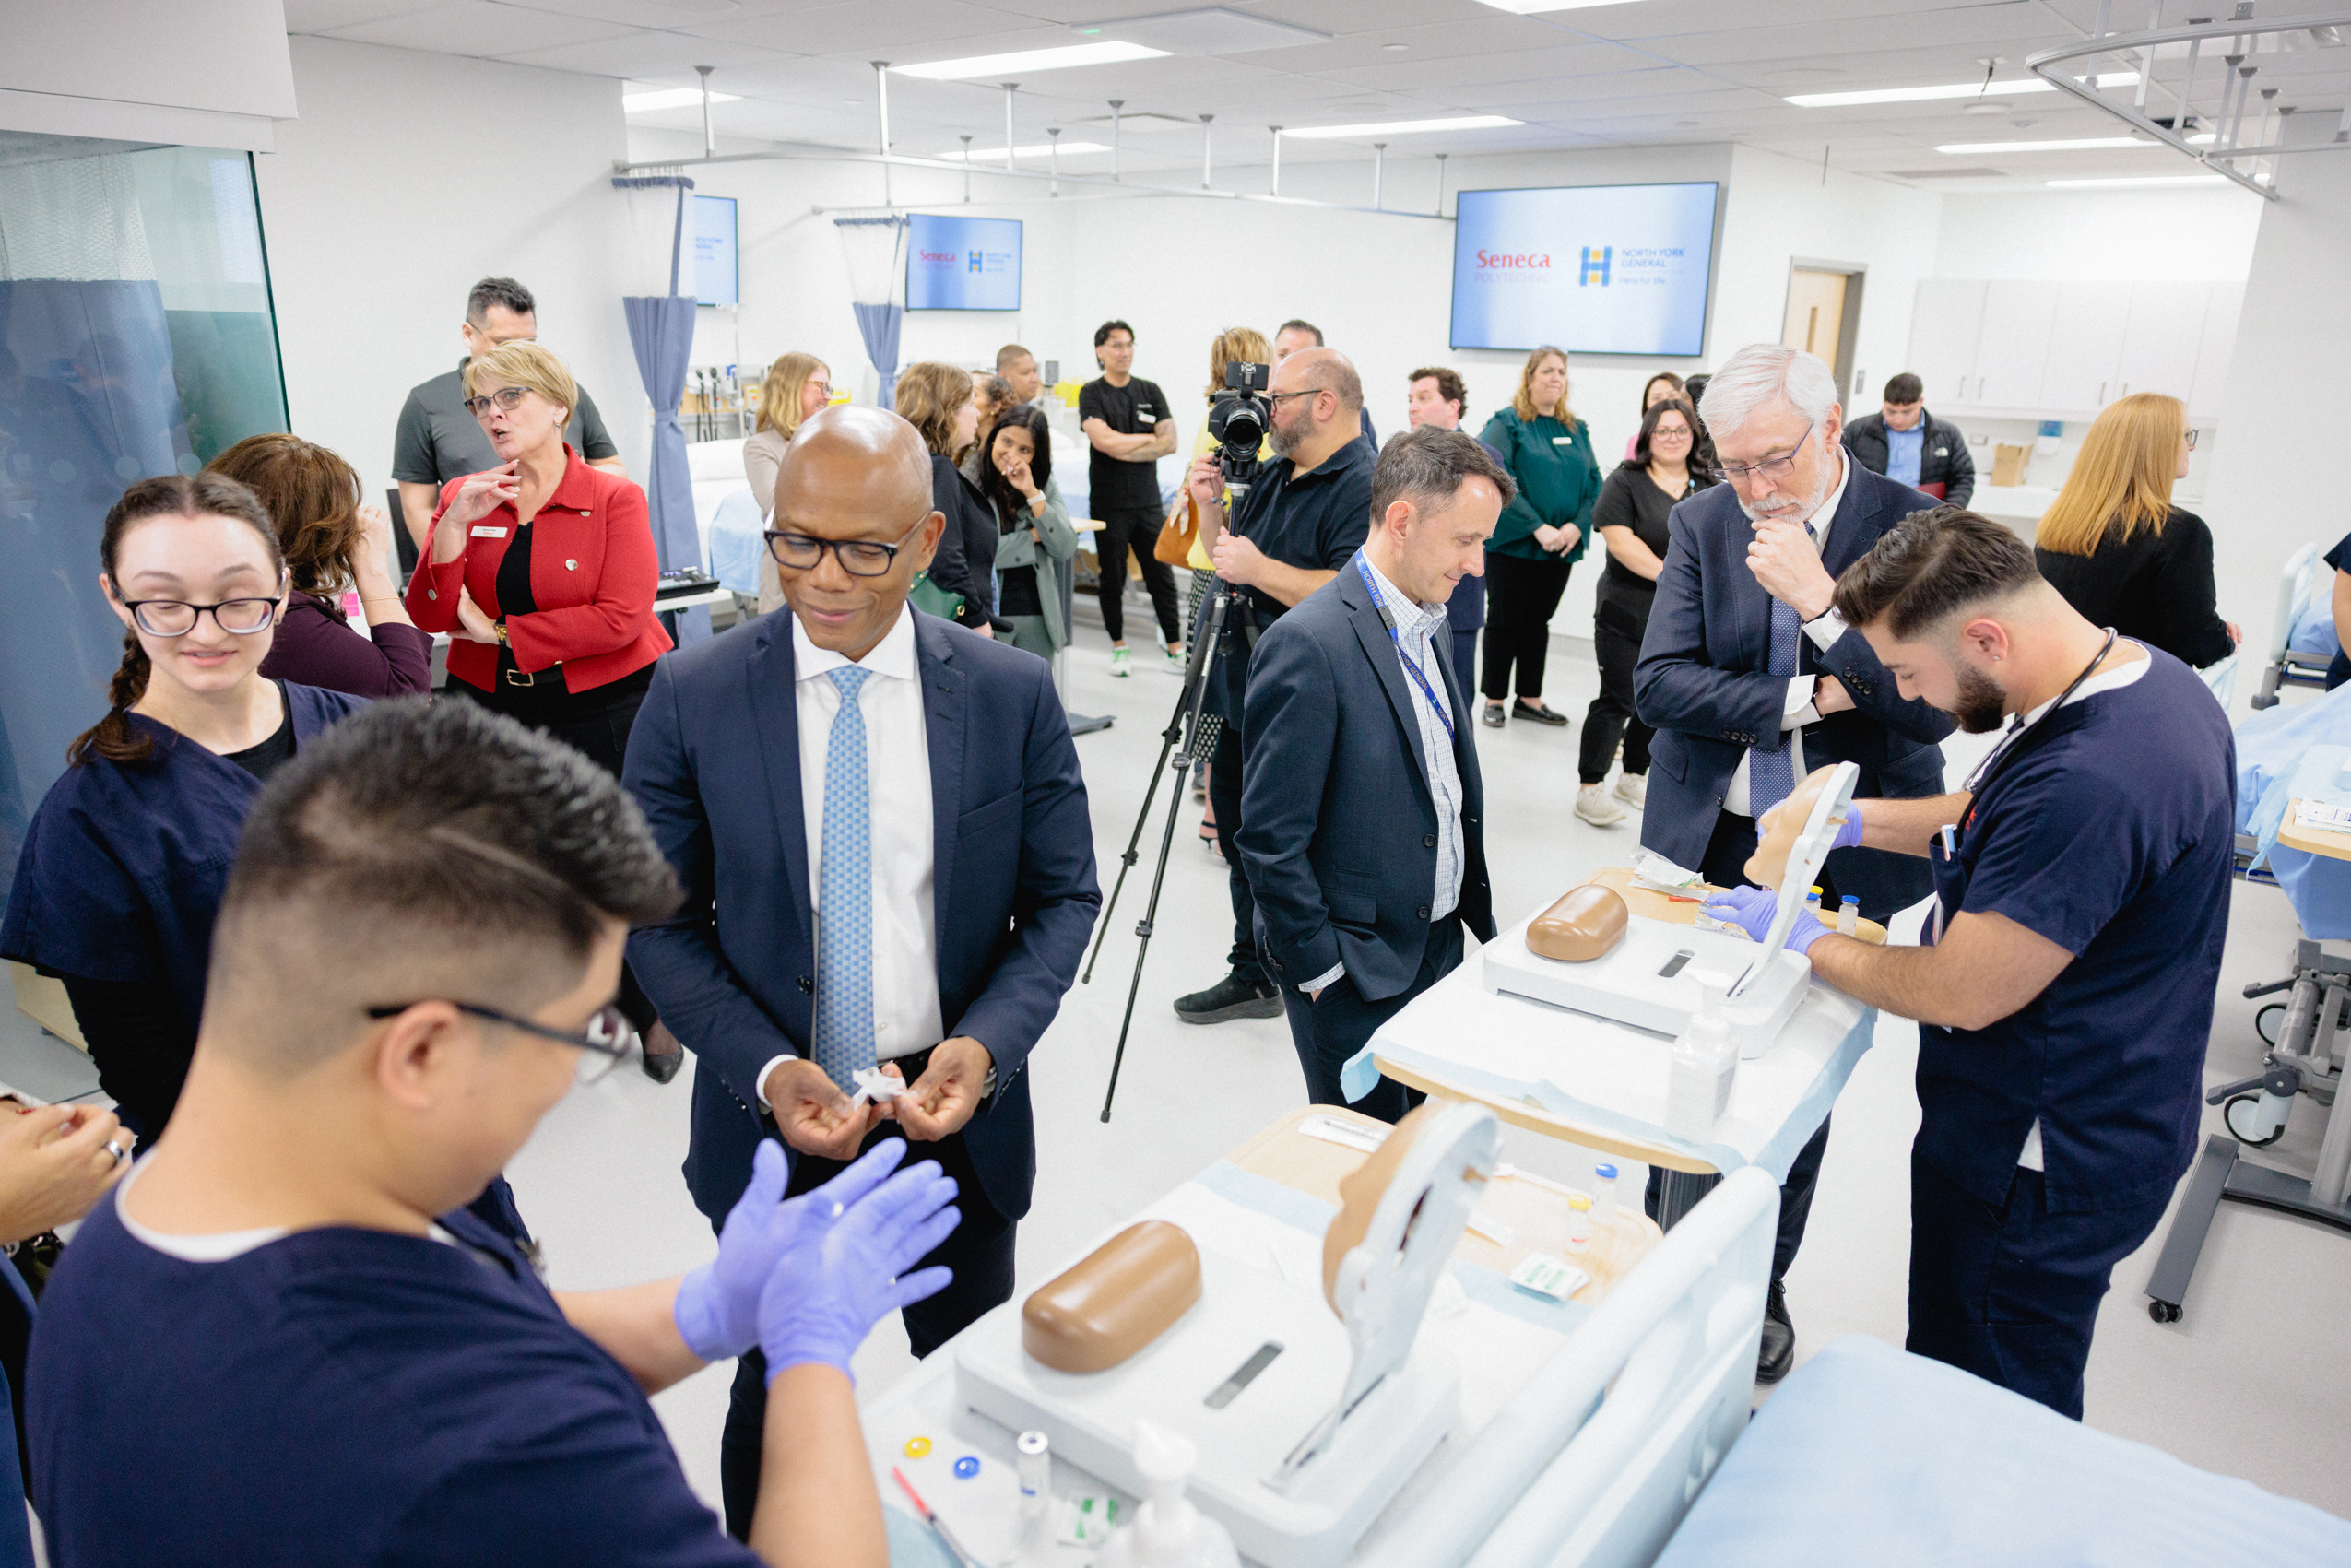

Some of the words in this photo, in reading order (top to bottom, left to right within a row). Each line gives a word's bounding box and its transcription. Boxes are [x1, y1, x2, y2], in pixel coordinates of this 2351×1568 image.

[920, 249, 956, 262] Seneca
[1477, 249, 1551, 268] Seneca
[1622, 248, 1657, 257] NORTH
[1659, 248, 1686, 257] YORK
[1621, 259, 1667, 267] GENERAL
[1363, 570, 1377, 594] NORTH
[1374, 593, 1384, 607] YOR
[1410, 666, 1429, 691] GENERAL
